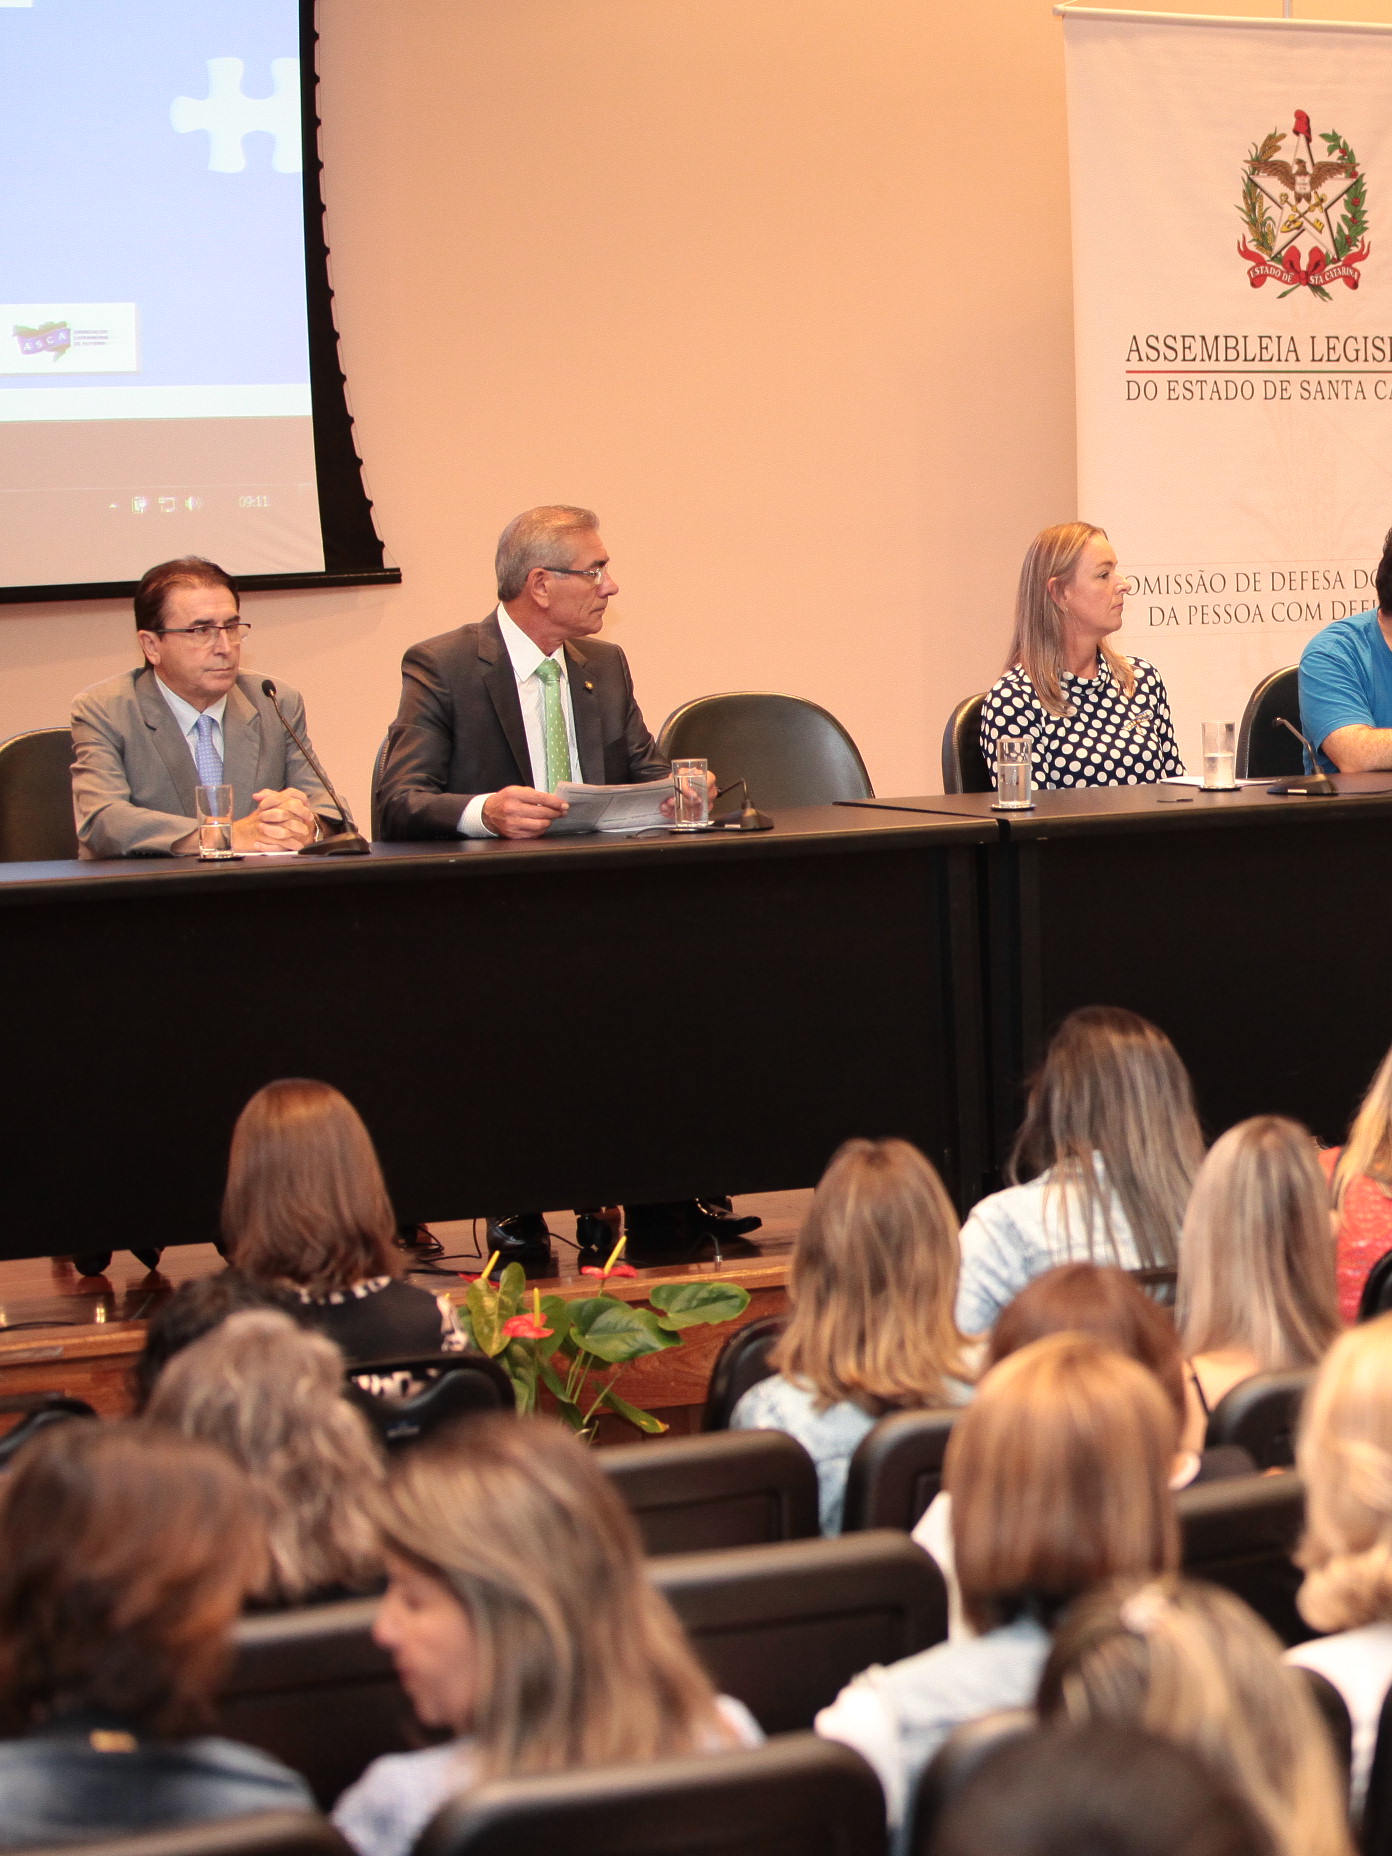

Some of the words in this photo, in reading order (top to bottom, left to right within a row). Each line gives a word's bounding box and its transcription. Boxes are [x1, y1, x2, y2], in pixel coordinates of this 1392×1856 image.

[1249, 265, 1281, 278] ESTADO
[1282, 272, 1293, 283] DE
[1324, 266, 1358, 281] CATARINA
[1125, 335, 1300, 362] ASSEMBLEIA
[1126, 380, 1158, 401] DO
[1167, 380, 1255, 401] ESTADO
[1264, 380, 1292, 400] DE
[1299, 380, 1367, 400] SANTA
[1125, 570, 1226, 596] OMISSÃO
[1236, 572, 1262, 593] DE
[1271, 569, 1345, 592] DEFESA
[1149, 606, 1180, 626] DA
[1188, 603, 1265, 625] PESSOA
[1271, 601, 1322, 624] COM
